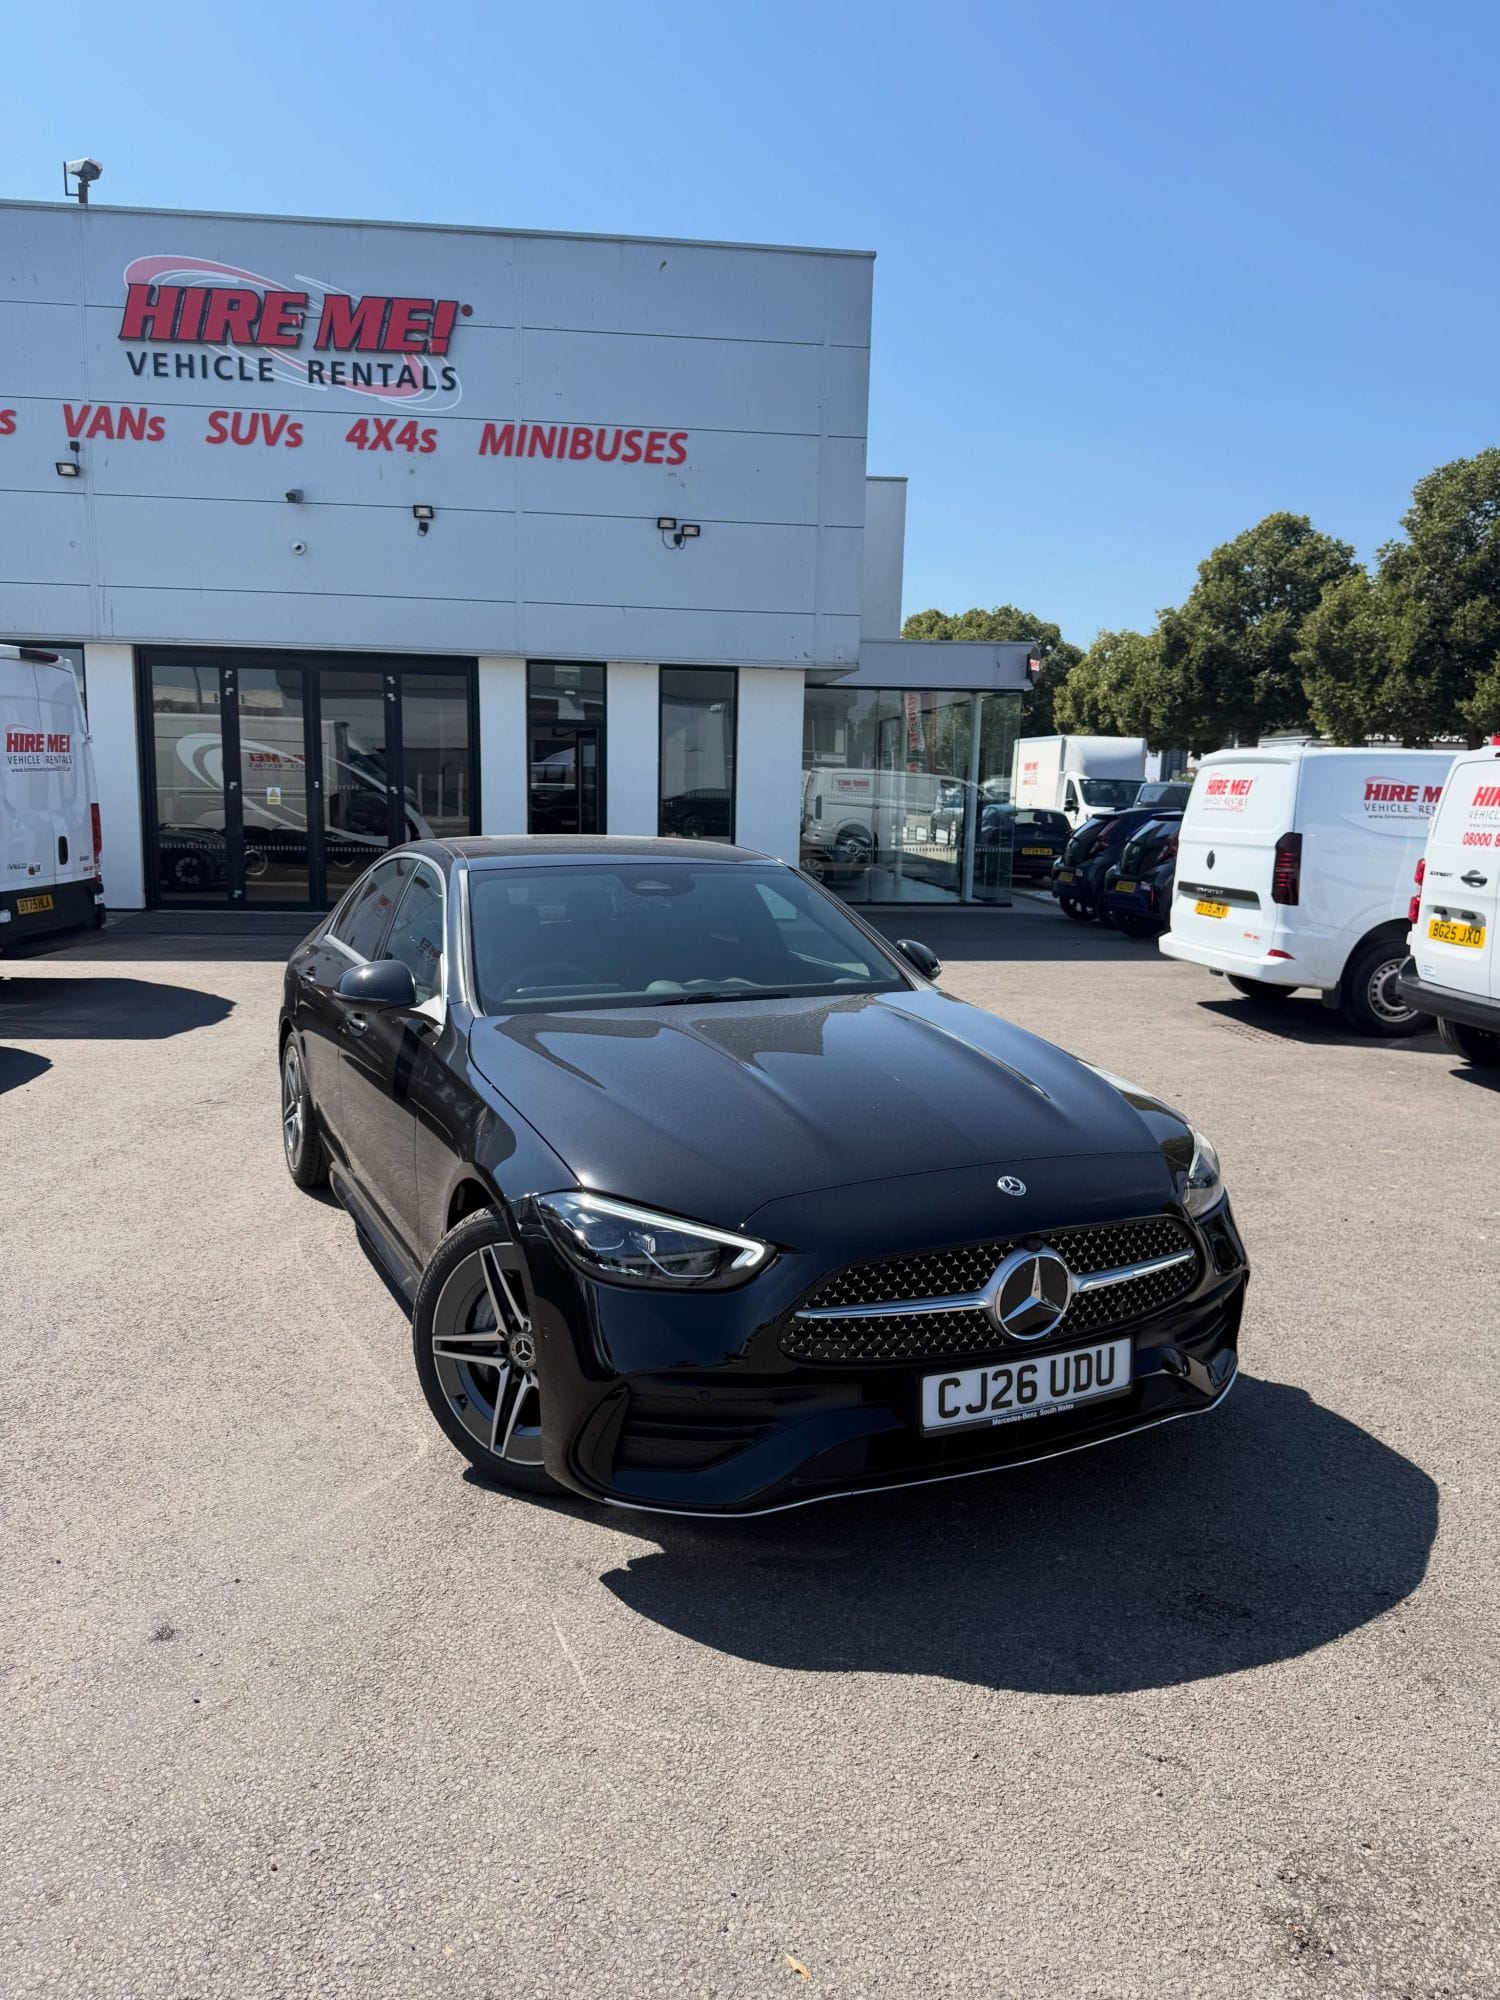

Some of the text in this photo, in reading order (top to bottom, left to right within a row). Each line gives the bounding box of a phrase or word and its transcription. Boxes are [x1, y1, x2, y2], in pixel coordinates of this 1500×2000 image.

[118, 283, 459, 357] HIRE ME!
[126, 351, 457, 391] VEHICLE RENTALS
[63, 404, 166, 441] VANs
[205, 410, 304, 448] SUVs
[345, 418, 438, 453] 4X4s
[478, 423, 689, 465] MINIBUSES
[6, 732, 45, 752] HIRE
[7, 755, 73, 765] VEHICLE RENTALS
[1206, 779, 1231, 795] HIRE
[1364, 784, 1420, 802] HIRE
[1364, 803, 1409, 813] VEHICLE
[1462, 832, 1492, 846] 08000
[1432, 922, 1457, 940] BG25
[938, 1347, 1115, 1419] CJ26 UDU
[992, 1410, 1038, 1426] Mercedes-Benz
[1039, 1406, 1057, 1416] South
[1057, 1403, 1074, 1412] Wales
